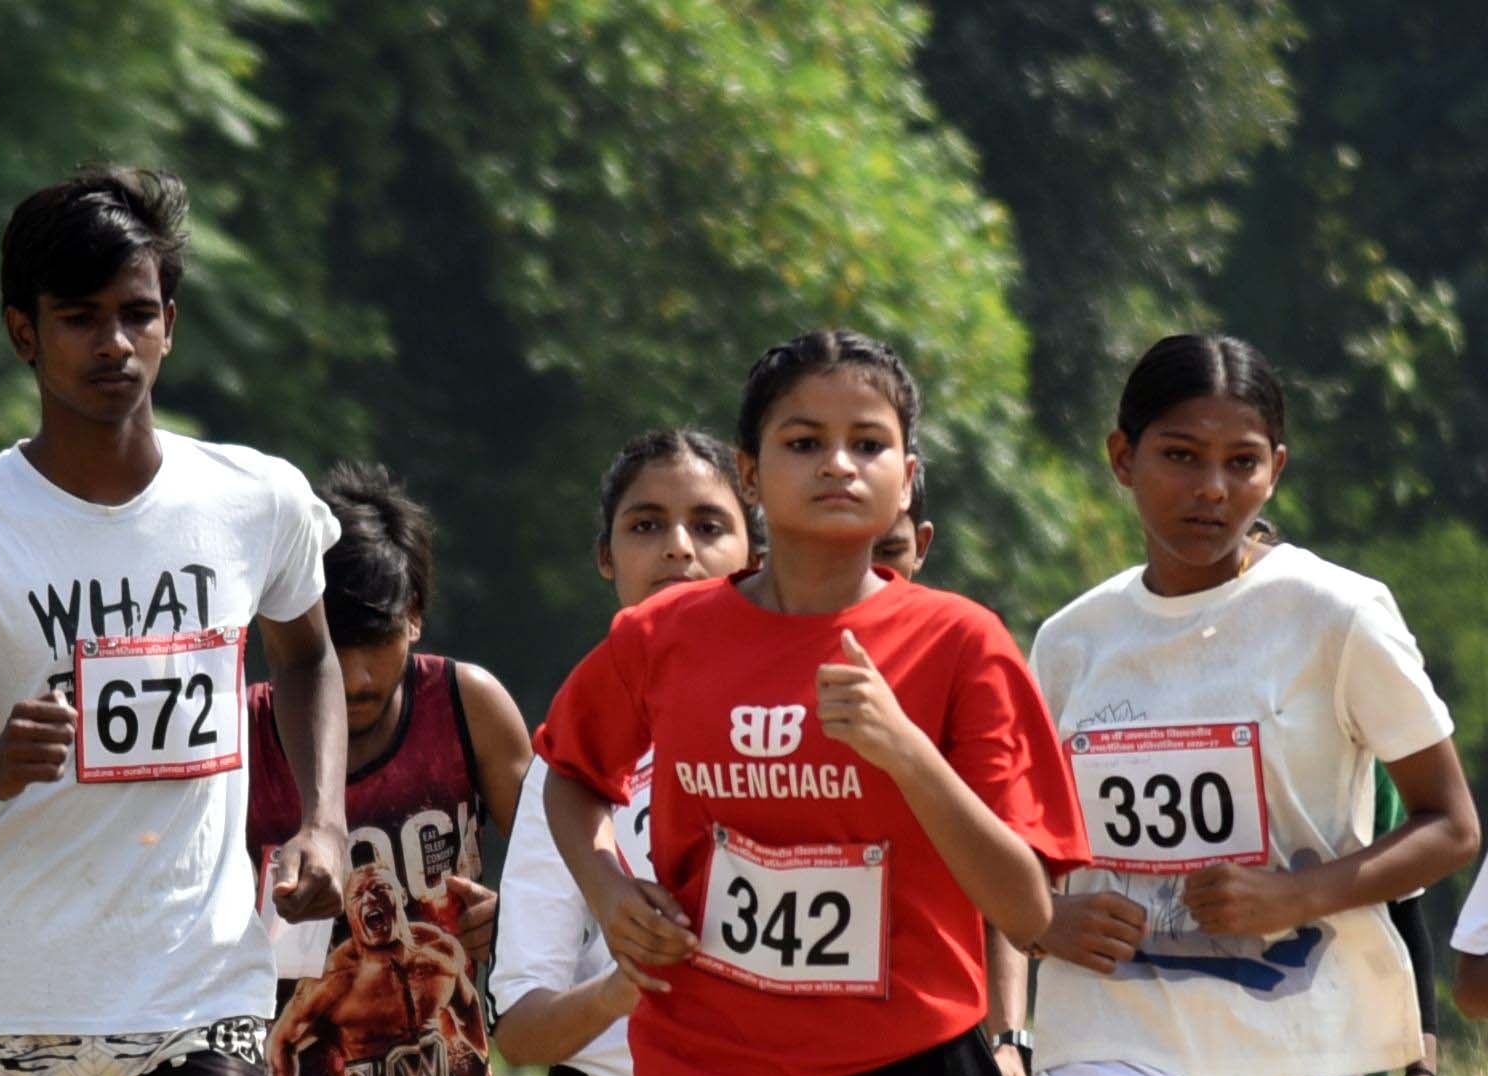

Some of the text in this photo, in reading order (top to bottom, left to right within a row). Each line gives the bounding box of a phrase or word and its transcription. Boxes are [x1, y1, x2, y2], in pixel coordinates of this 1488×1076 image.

[28, 563, 217, 661] WHAT
[97, 673, 218, 754] 672
[675, 761, 863, 800] BALENCIAGA
[1098, 771, 1234, 848] 330
[721, 876, 852, 967] 342
